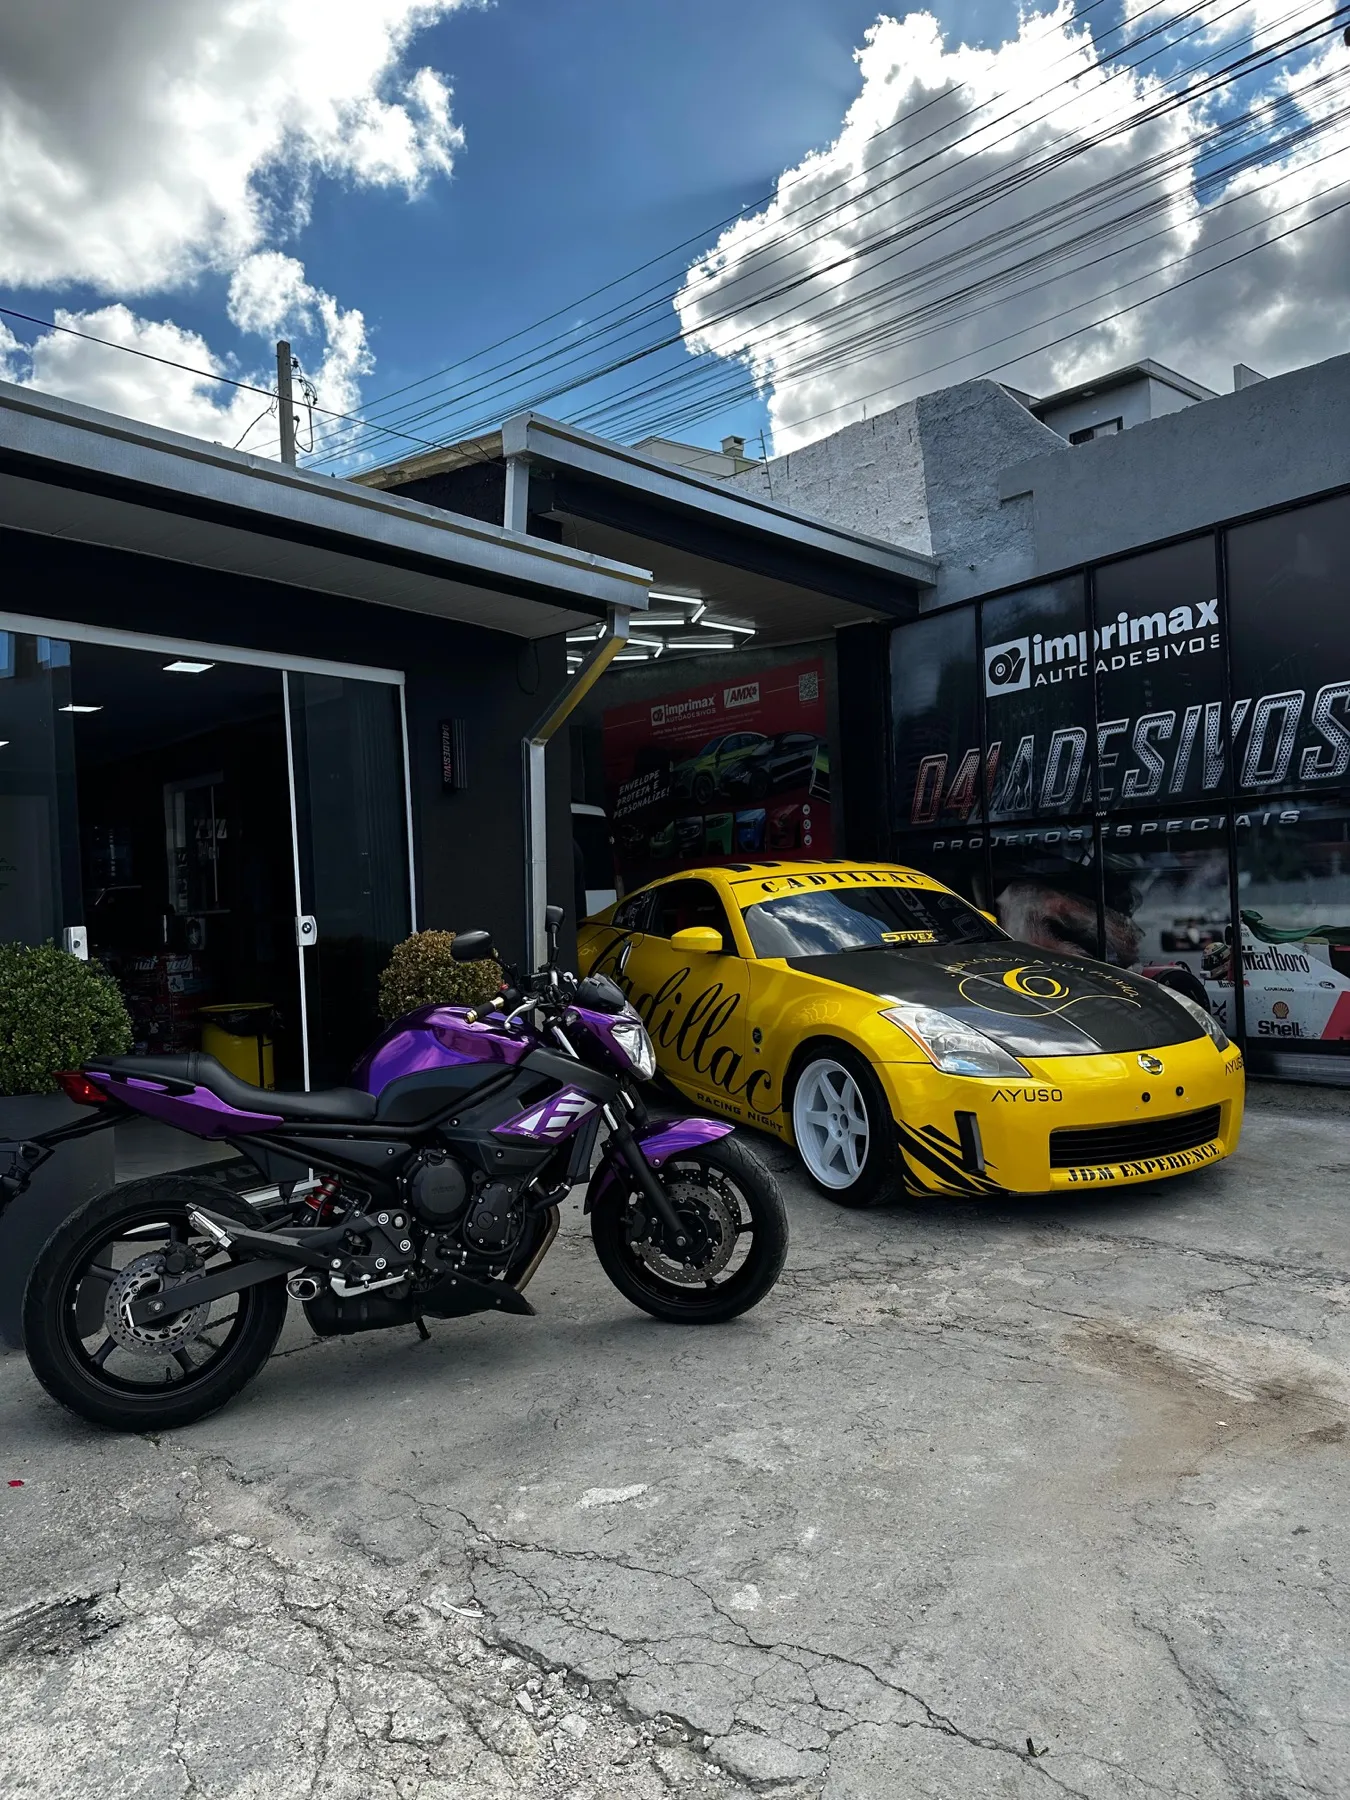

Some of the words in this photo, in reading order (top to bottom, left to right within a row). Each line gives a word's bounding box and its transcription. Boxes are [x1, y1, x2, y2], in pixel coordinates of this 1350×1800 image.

[1032, 599, 1219, 666] imprimax
[1034, 634, 1220, 687] AUTOADESIVOS
[665, 697, 715, 716] imprimax
[619, 769, 661, 796] ENVELOPE
[933, 830, 1083, 851] PROJETOS
[761, 871, 924, 893] CADILLAC
[1242, 946, 1310, 973] Marlboro
[577, 929, 784, 1115] Cdillac
[1258, 1020, 1300, 1037] Shell
[991, 1089, 1063, 1103] AYUSO
[697, 1093, 742, 1116] RACING
[747, 1111, 784, 1133] NIGHT
[1068, 1167, 1115, 1183] JDM
[1119, 1143, 1220, 1178] EXPERIENCE
